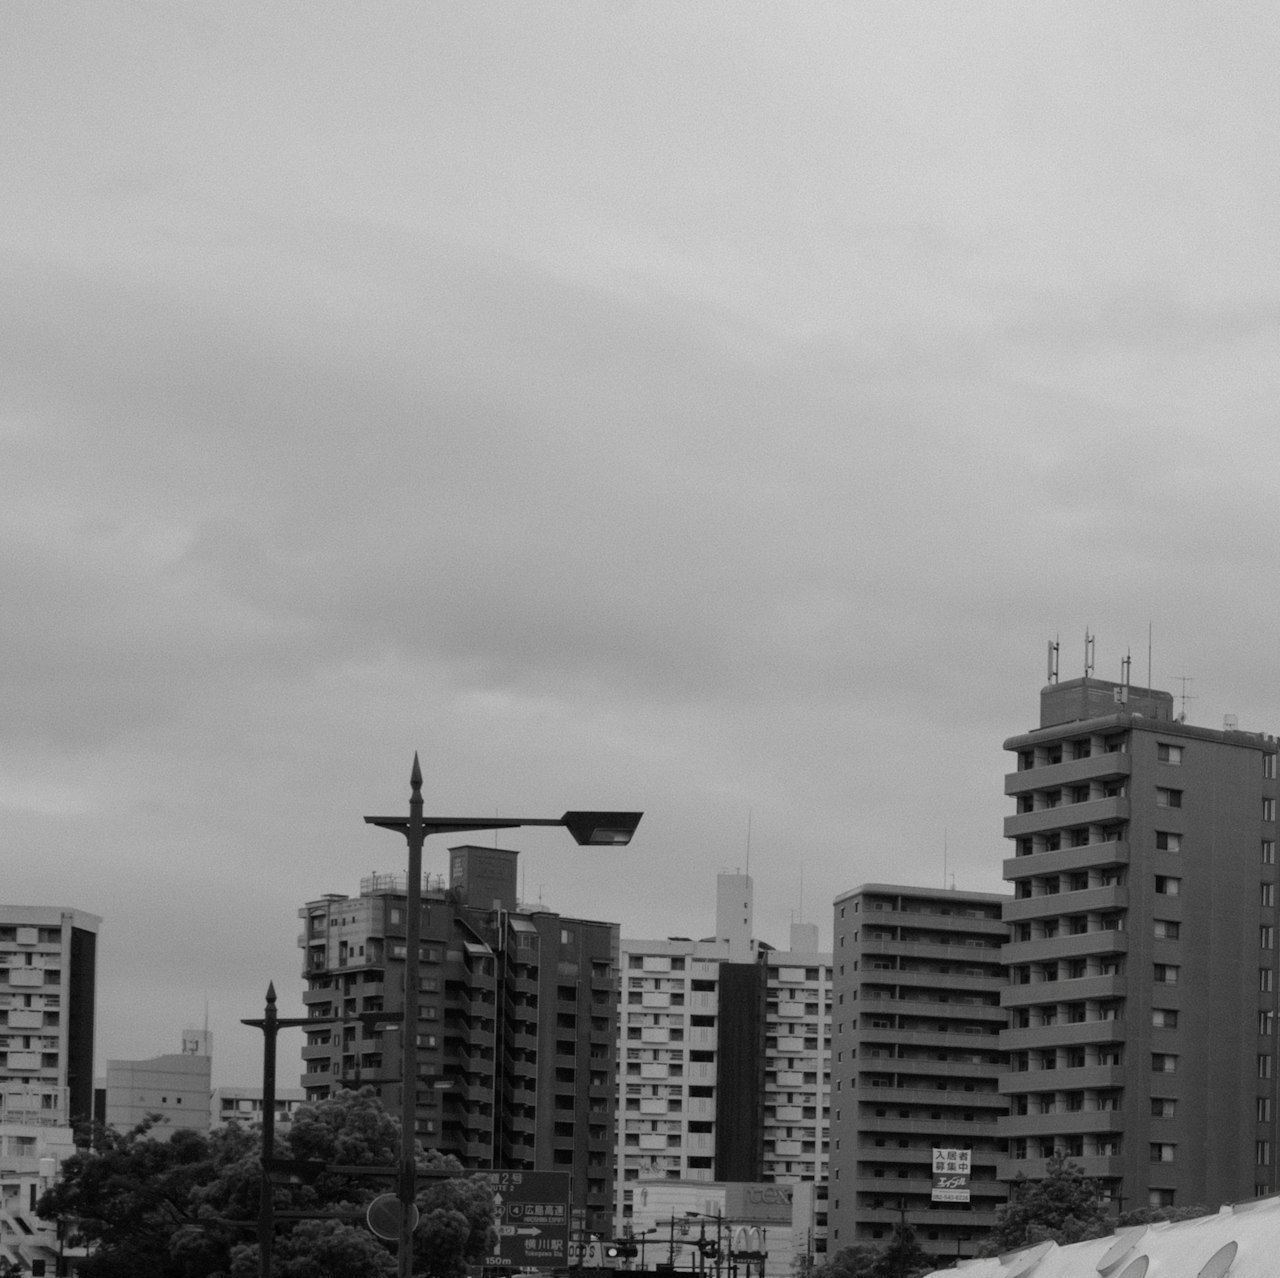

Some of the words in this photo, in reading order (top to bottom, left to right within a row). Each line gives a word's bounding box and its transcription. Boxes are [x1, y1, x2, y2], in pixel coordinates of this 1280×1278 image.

[935, 1150, 968, 1161] 入居者
[935, 1161, 968, 1172] 募集中
[524, 1239, 564, 1250] 横川駅
